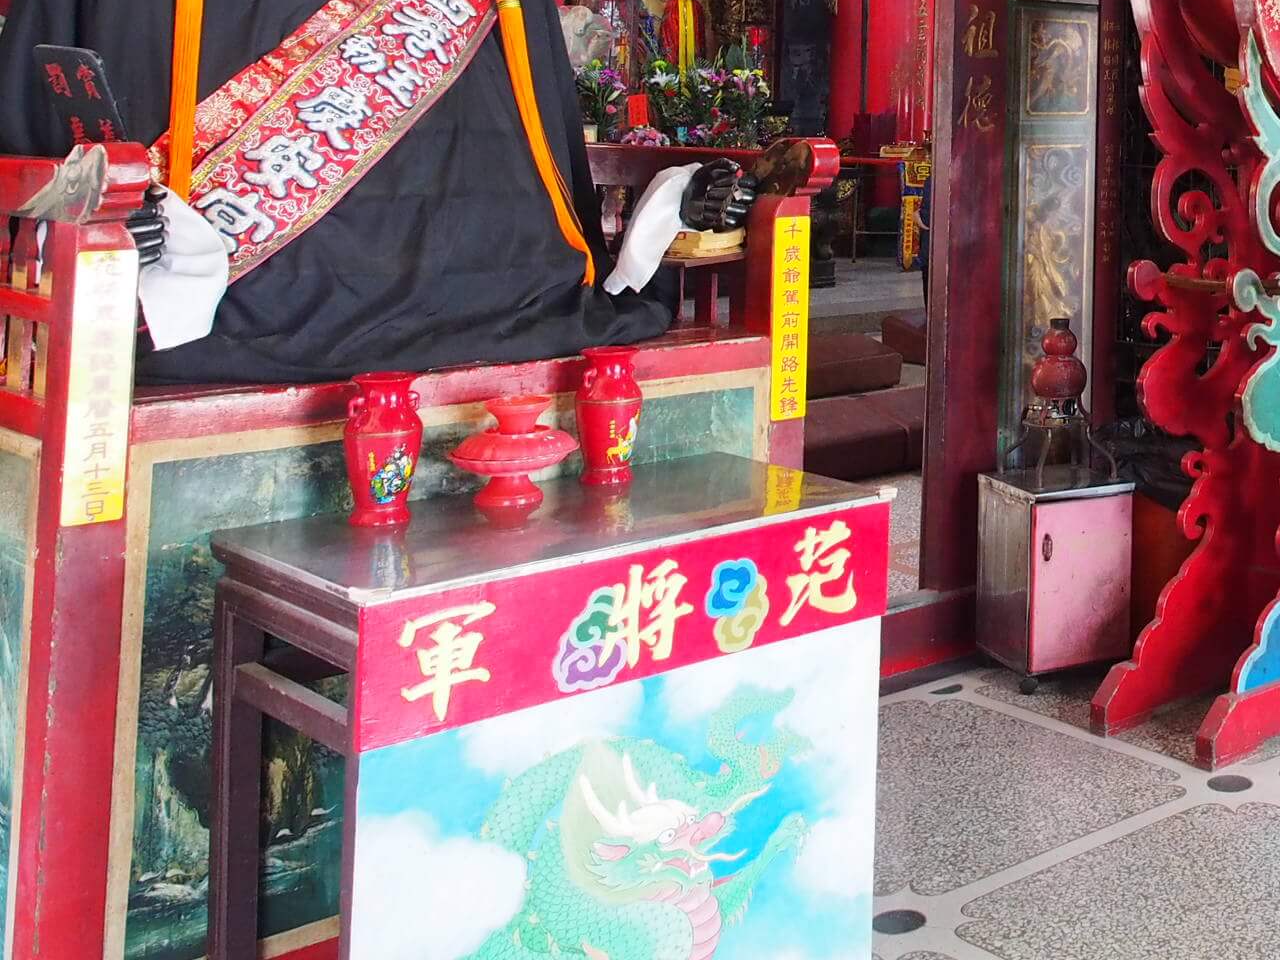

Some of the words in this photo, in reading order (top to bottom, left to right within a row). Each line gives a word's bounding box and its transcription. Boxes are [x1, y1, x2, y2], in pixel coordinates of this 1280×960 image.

[195, 84, 373, 254] 慶安宮
[780, 223, 803, 415] 千歲爺駕前開路先鋒
